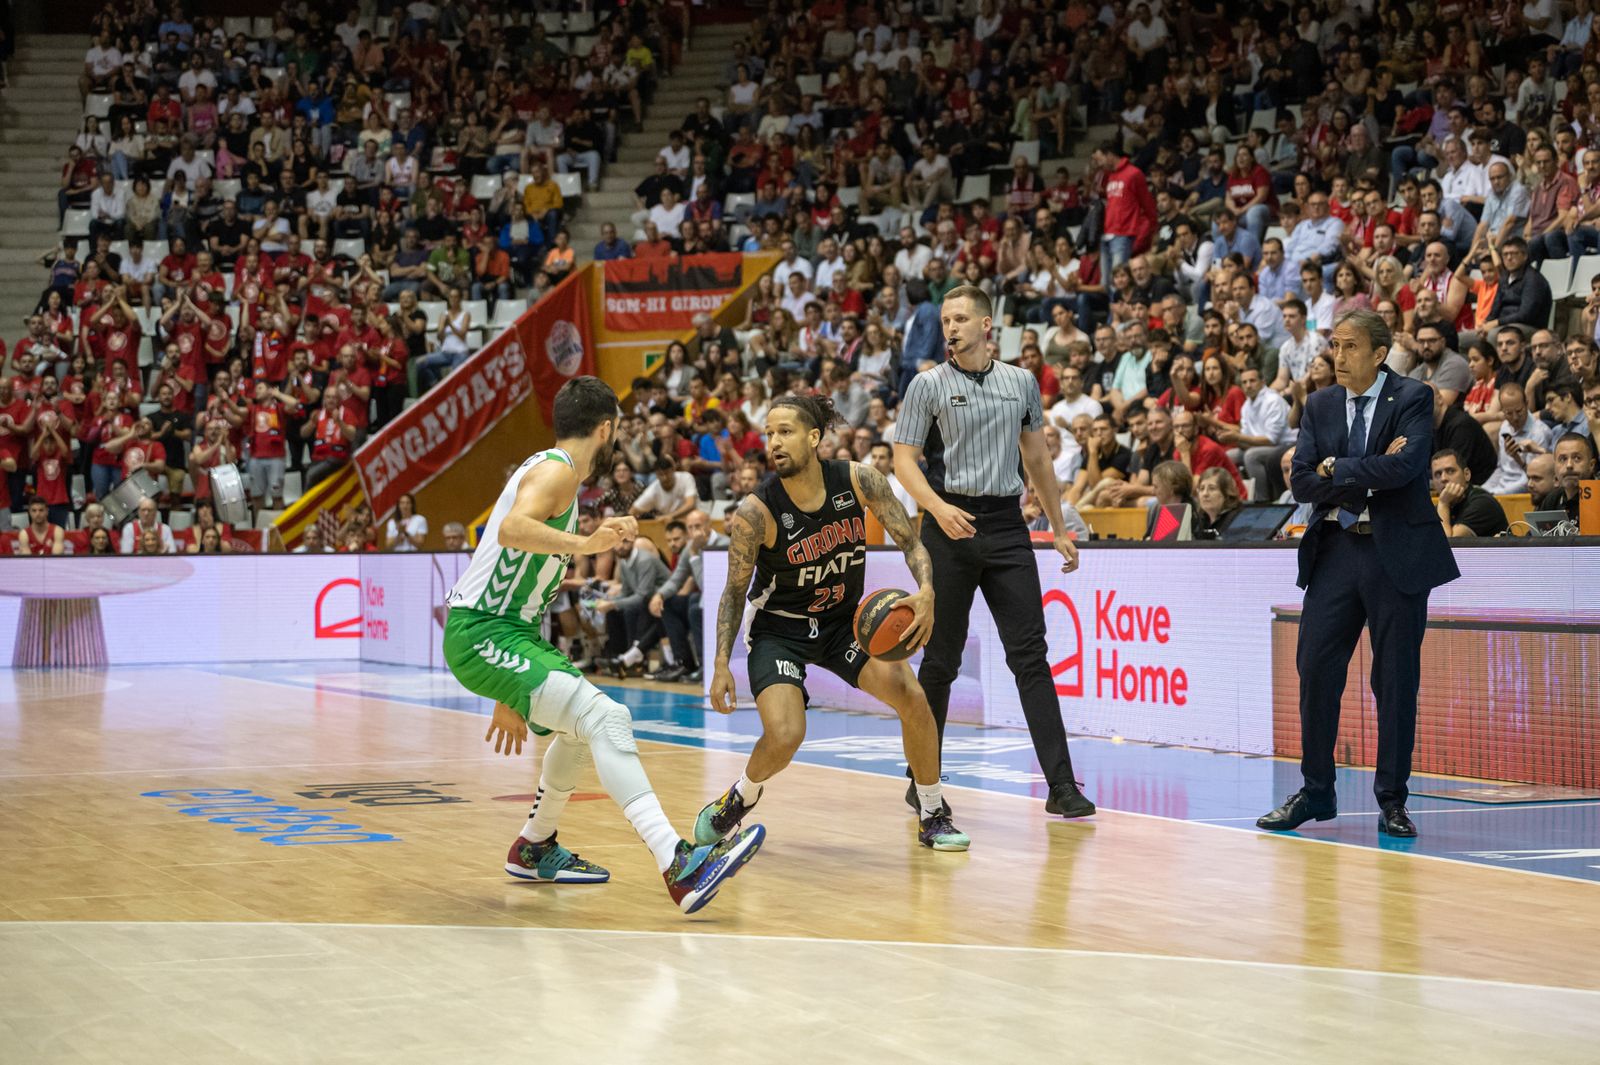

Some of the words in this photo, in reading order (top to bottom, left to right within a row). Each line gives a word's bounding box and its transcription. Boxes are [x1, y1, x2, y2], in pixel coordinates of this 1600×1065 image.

[672, 294, 732, 311] GIRON
[787, 517, 866, 565] GIRONA
[807, 582, 846, 613] 23
[1095, 590, 1171, 644] Kave
[1096, 648, 1188, 706] Home
[139, 788, 404, 846] endesa
